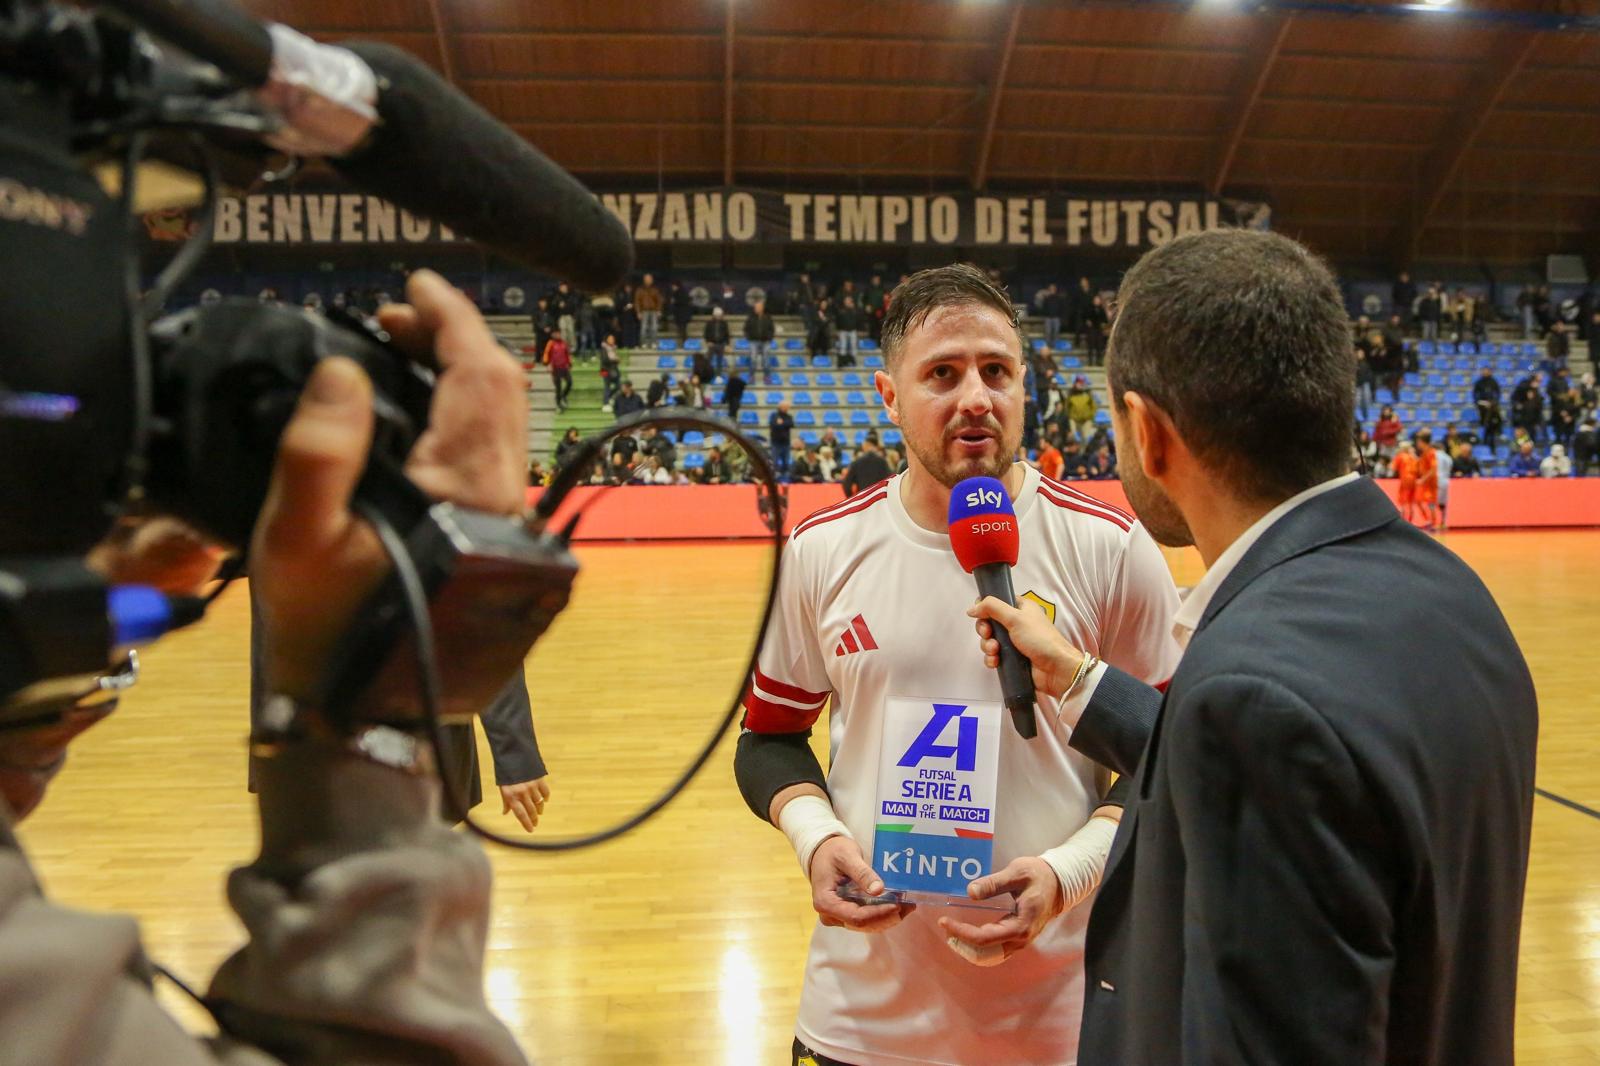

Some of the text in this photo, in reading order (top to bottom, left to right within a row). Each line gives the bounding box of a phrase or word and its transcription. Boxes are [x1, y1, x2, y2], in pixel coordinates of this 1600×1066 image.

[214, 195, 474, 242] BENVENU
[602, 191, 757, 242] NZANO
[784, 193, 960, 244] TEMPIO
[974, 197, 1053, 246] DEL
[965, 488, 1002, 508] sky
[972, 520, 1012, 535] sport
[919, 769, 957, 781] FUTSAL
[901, 779, 972, 802] SERIE A
[884, 803, 987, 822] MAN OF THE MATCH
